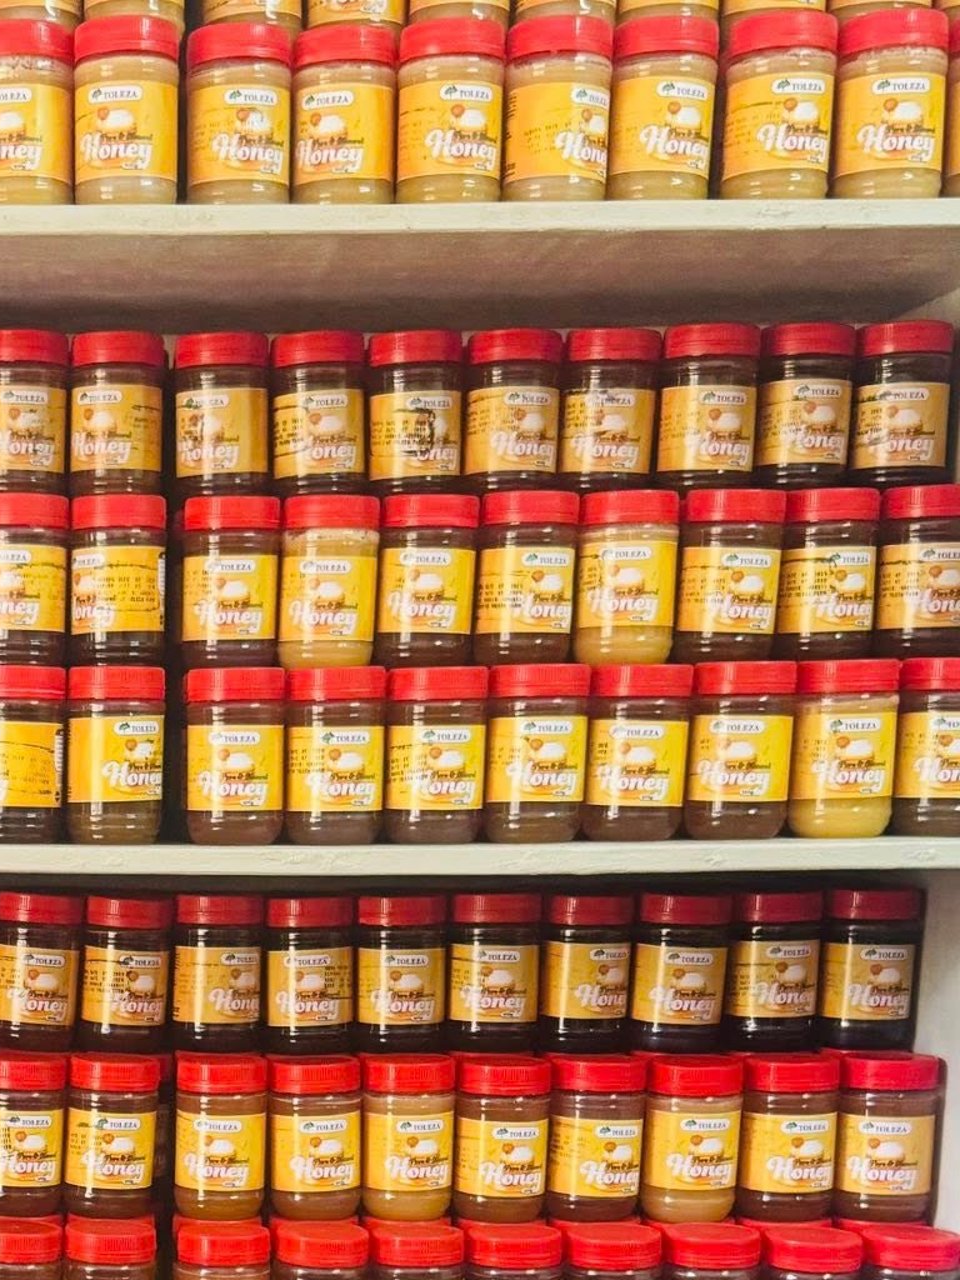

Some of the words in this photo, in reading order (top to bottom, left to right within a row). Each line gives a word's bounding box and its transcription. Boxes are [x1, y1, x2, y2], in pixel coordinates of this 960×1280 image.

[103, 89, 137, 99] TOLEZA
[244, 93, 275, 103] TOLEZA
[315, 93, 349, 104] TOLEZA
[459, 88, 490, 98] TOLEZA
[677, 87, 705, 97] TOLEZA
[792, 82, 822, 91] TOLEZA
[892, 82, 926, 90] TOLEZA
[81, 132, 153, 170] Honey
[212, 133, 283, 173] Honey
[296, 140, 364, 173] Honey
[425, 130, 496, 170] Honey
[640, 124, 708, 169] Honey
[757, 123, 827, 161] Honey
[857, 123, 934, 161] Honey
[73, 431, 131, 463] Honey
[493, 432, 553, 466] Honey
[194, 601, 262, 634] Honey
[291, 600, 357, 634] Honey
[390, 594, 455, 627] Honey
[521, 595, 572, 627] Honey
[590, 587, 656, 622] Honey
[713, 597, 774, 629] Honey
[103, 762, 162, 796] Honey
[199, 772, 267, 804] Honey
[306, 772, 375, 806] Honey
[410, 774, 476, 804] Honey
[507, 762, 576, 795] Honey
[597, 762, 669, 799] Honey
[695, 760, 767, 794] Honey
[812, 757, 884, 794] Honey
[7, 987, 68, 1021] Honey
[276, 989, 338, 1020] Honey
[371, 988, 434, 1020] Honey
[459, 987, 525, 1018] Honey
[651, 984, 715, 1019] Honey
[0, 1151, 56, 1180] Honey
[83, 1152, 143, 1184] Honey
[185, 1154, 249, 1186] Honey
[291, 1157, 353, 1186] Honey
[384, 1156, 447, 1184] Honey
[483, 1162, 542, 1194] Honey
[667, 1154, 733, 1185] Honey
[768, 1155, 831, 1187] Honey
[847, 1157, 916, 1189] Honey
